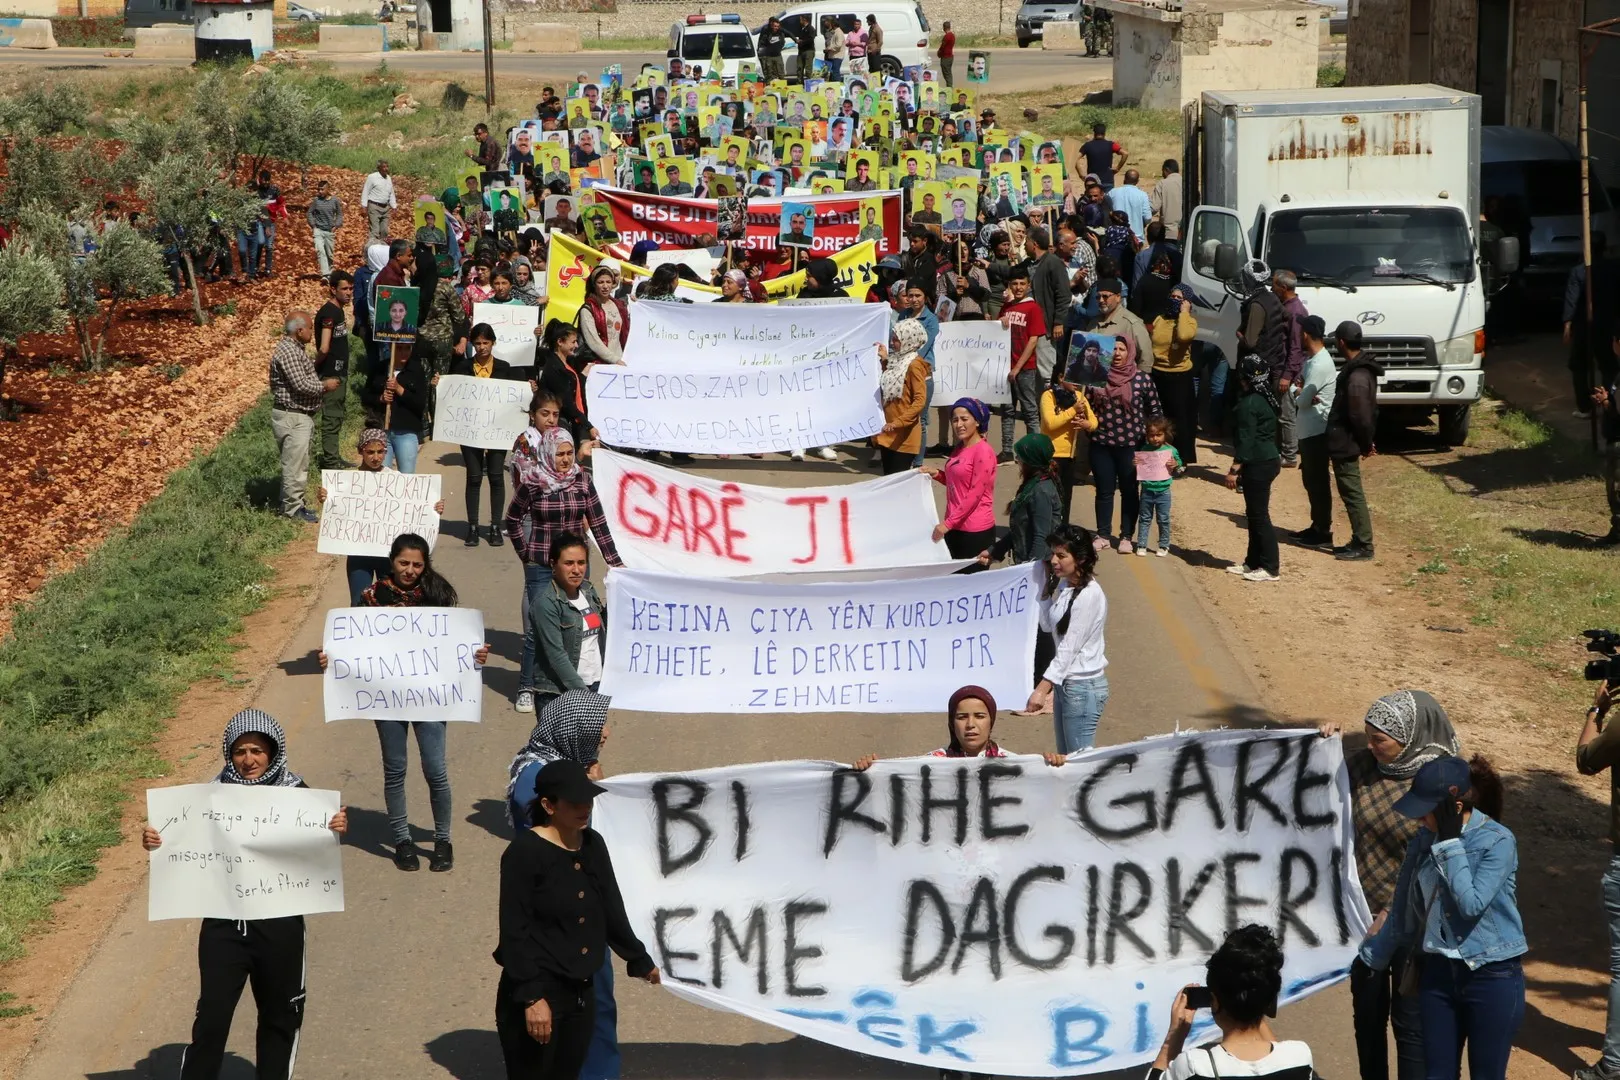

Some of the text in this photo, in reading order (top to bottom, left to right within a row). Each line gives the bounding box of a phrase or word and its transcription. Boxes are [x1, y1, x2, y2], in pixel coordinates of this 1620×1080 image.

[632, 203, 681, 222] BESE
[684, 207, 700, 223] JI
[617, 471, 855, 564] GARÊ JI
[631, 598, 730, 634] KETINA
[828, 599, 875, 631] YÊN
[885, 579, 1029, 630] KURDISTANÊ
[333, 647, 439, 682] DIJMIN
[753, 640, 778, 675] LÊ
[792, 638, 927, 675] DERKETIN
[950, 633, 995, 669] PIR
[652, 734, 1338, 878] BI RIHE GARE
[323, 879, 337, 893] ye
[654, 846, 1350, 997] EME DAGIRKERI
